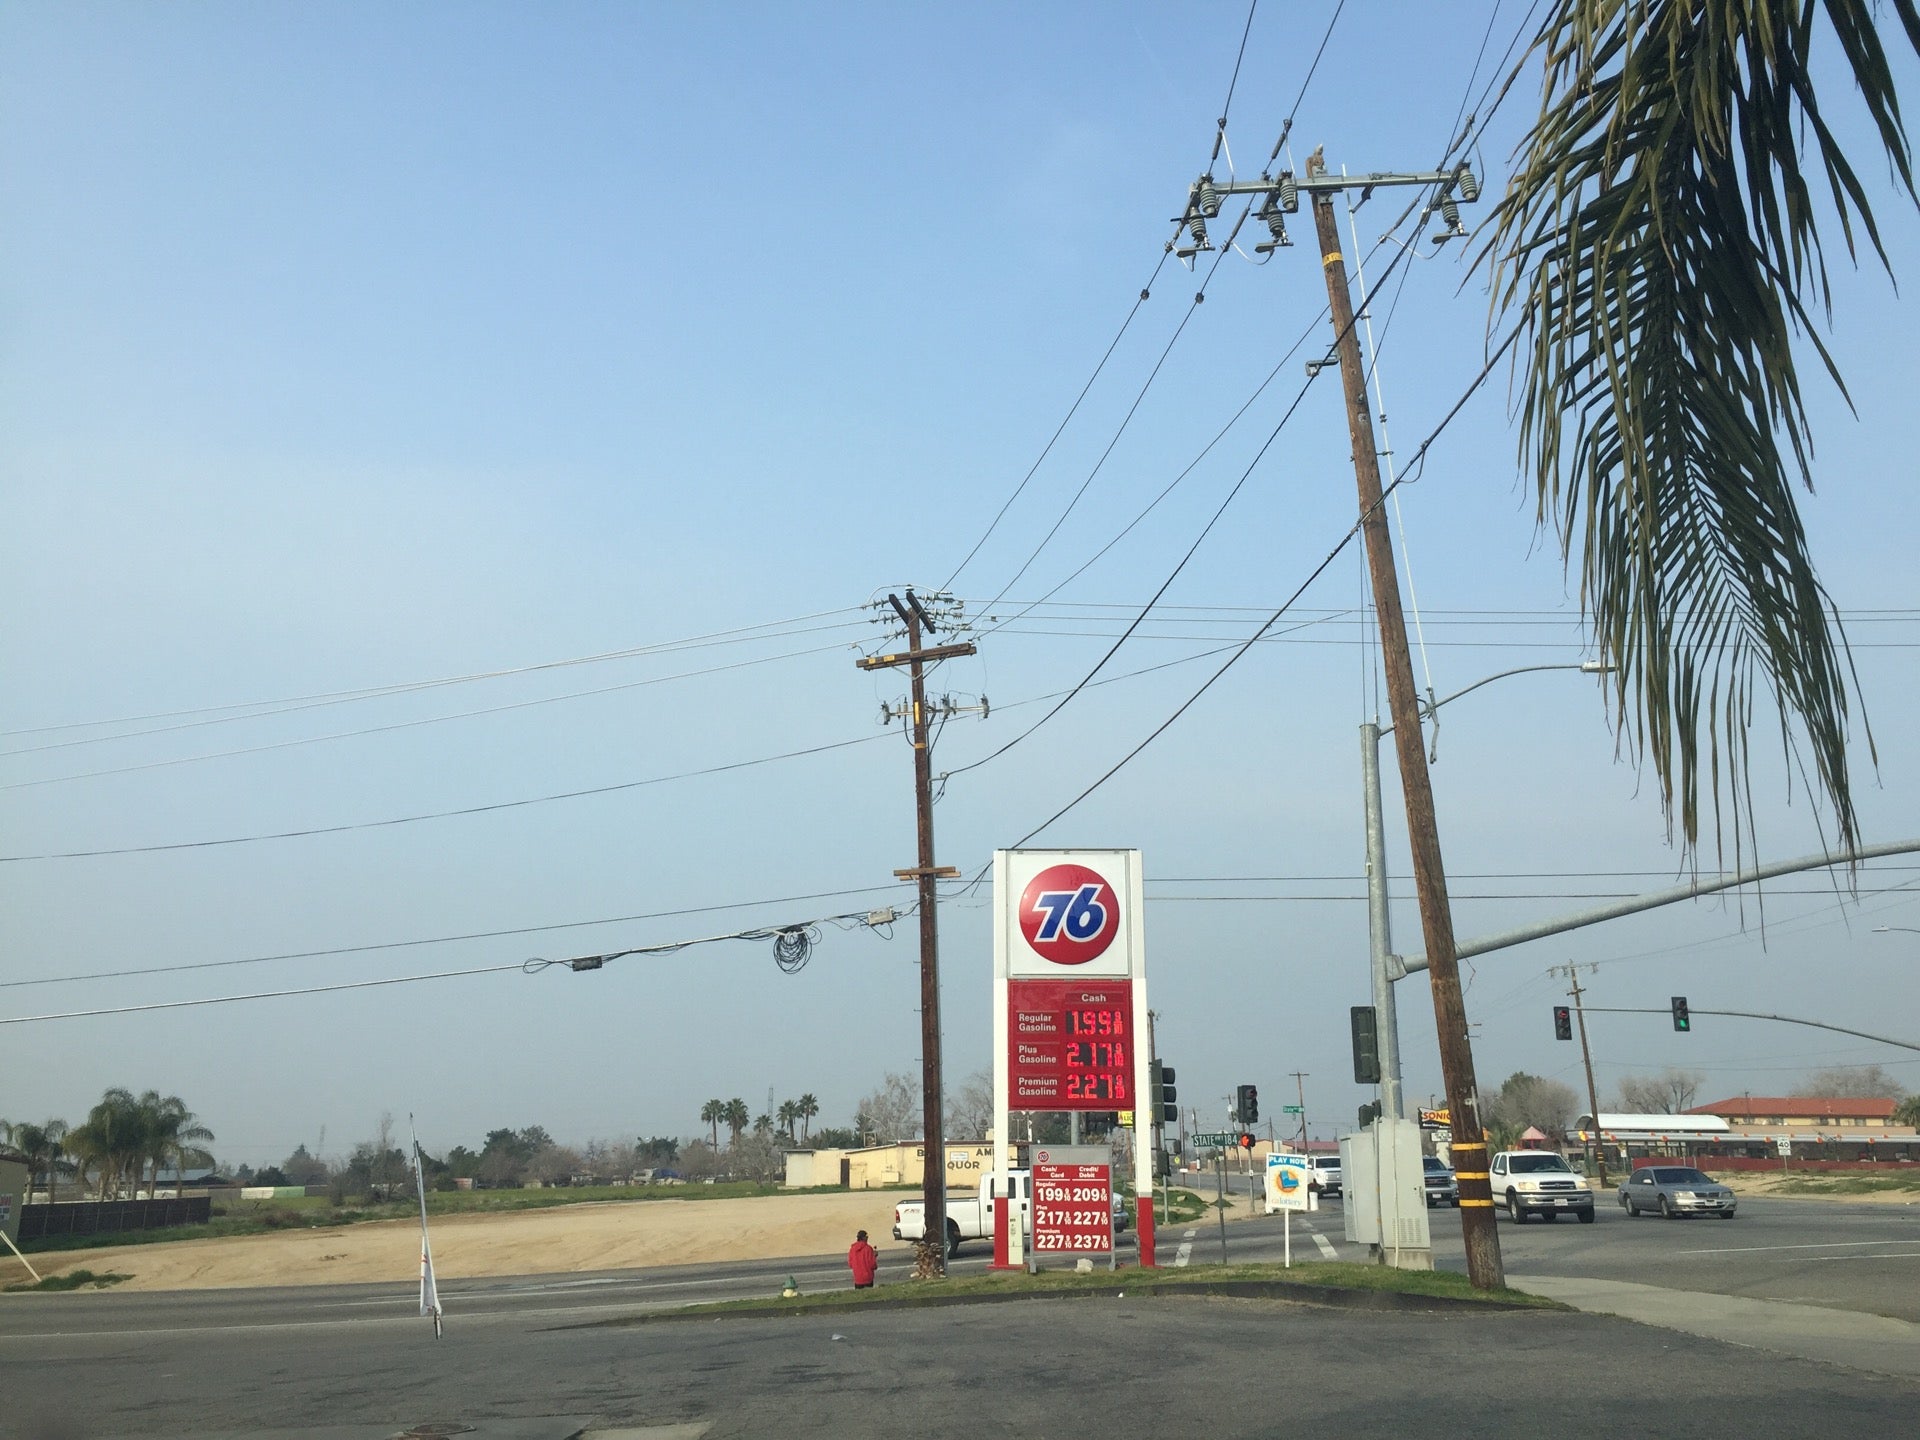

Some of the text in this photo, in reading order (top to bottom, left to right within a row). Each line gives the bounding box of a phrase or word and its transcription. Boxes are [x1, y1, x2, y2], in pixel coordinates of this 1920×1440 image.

[1032, 884, 1107, 942] 76
[1081, 993, 1106, 1002] Cash
[1019, 1013, 1052, 1023] Regular
[1019, 1023, 1056, 1032] Gasoline
[1019, 1045, 1037, 1054] Plus
[1019, 1055, 1056, 1064] Gasoline
[1019, 1077, 1057, 1086] Premium
[1019, 1087, 1056, 1096] Gasoline
[1194, 1135, 1215, 1146] STATE
[1224, 1134, 1238, 1145] 184
[947, 1161, 980, 1170] QUOR
[1037, 1188, 1063, 1202] 199
[1072, 1188, 1100, 1202] 209
[1036, 1211, 1064, 1225] 217
[1073, 1211, 1101, 1225] 227
[1037, 1234, 1065, 1249] 227
[1073, 1235, 1101, 1249] 237
